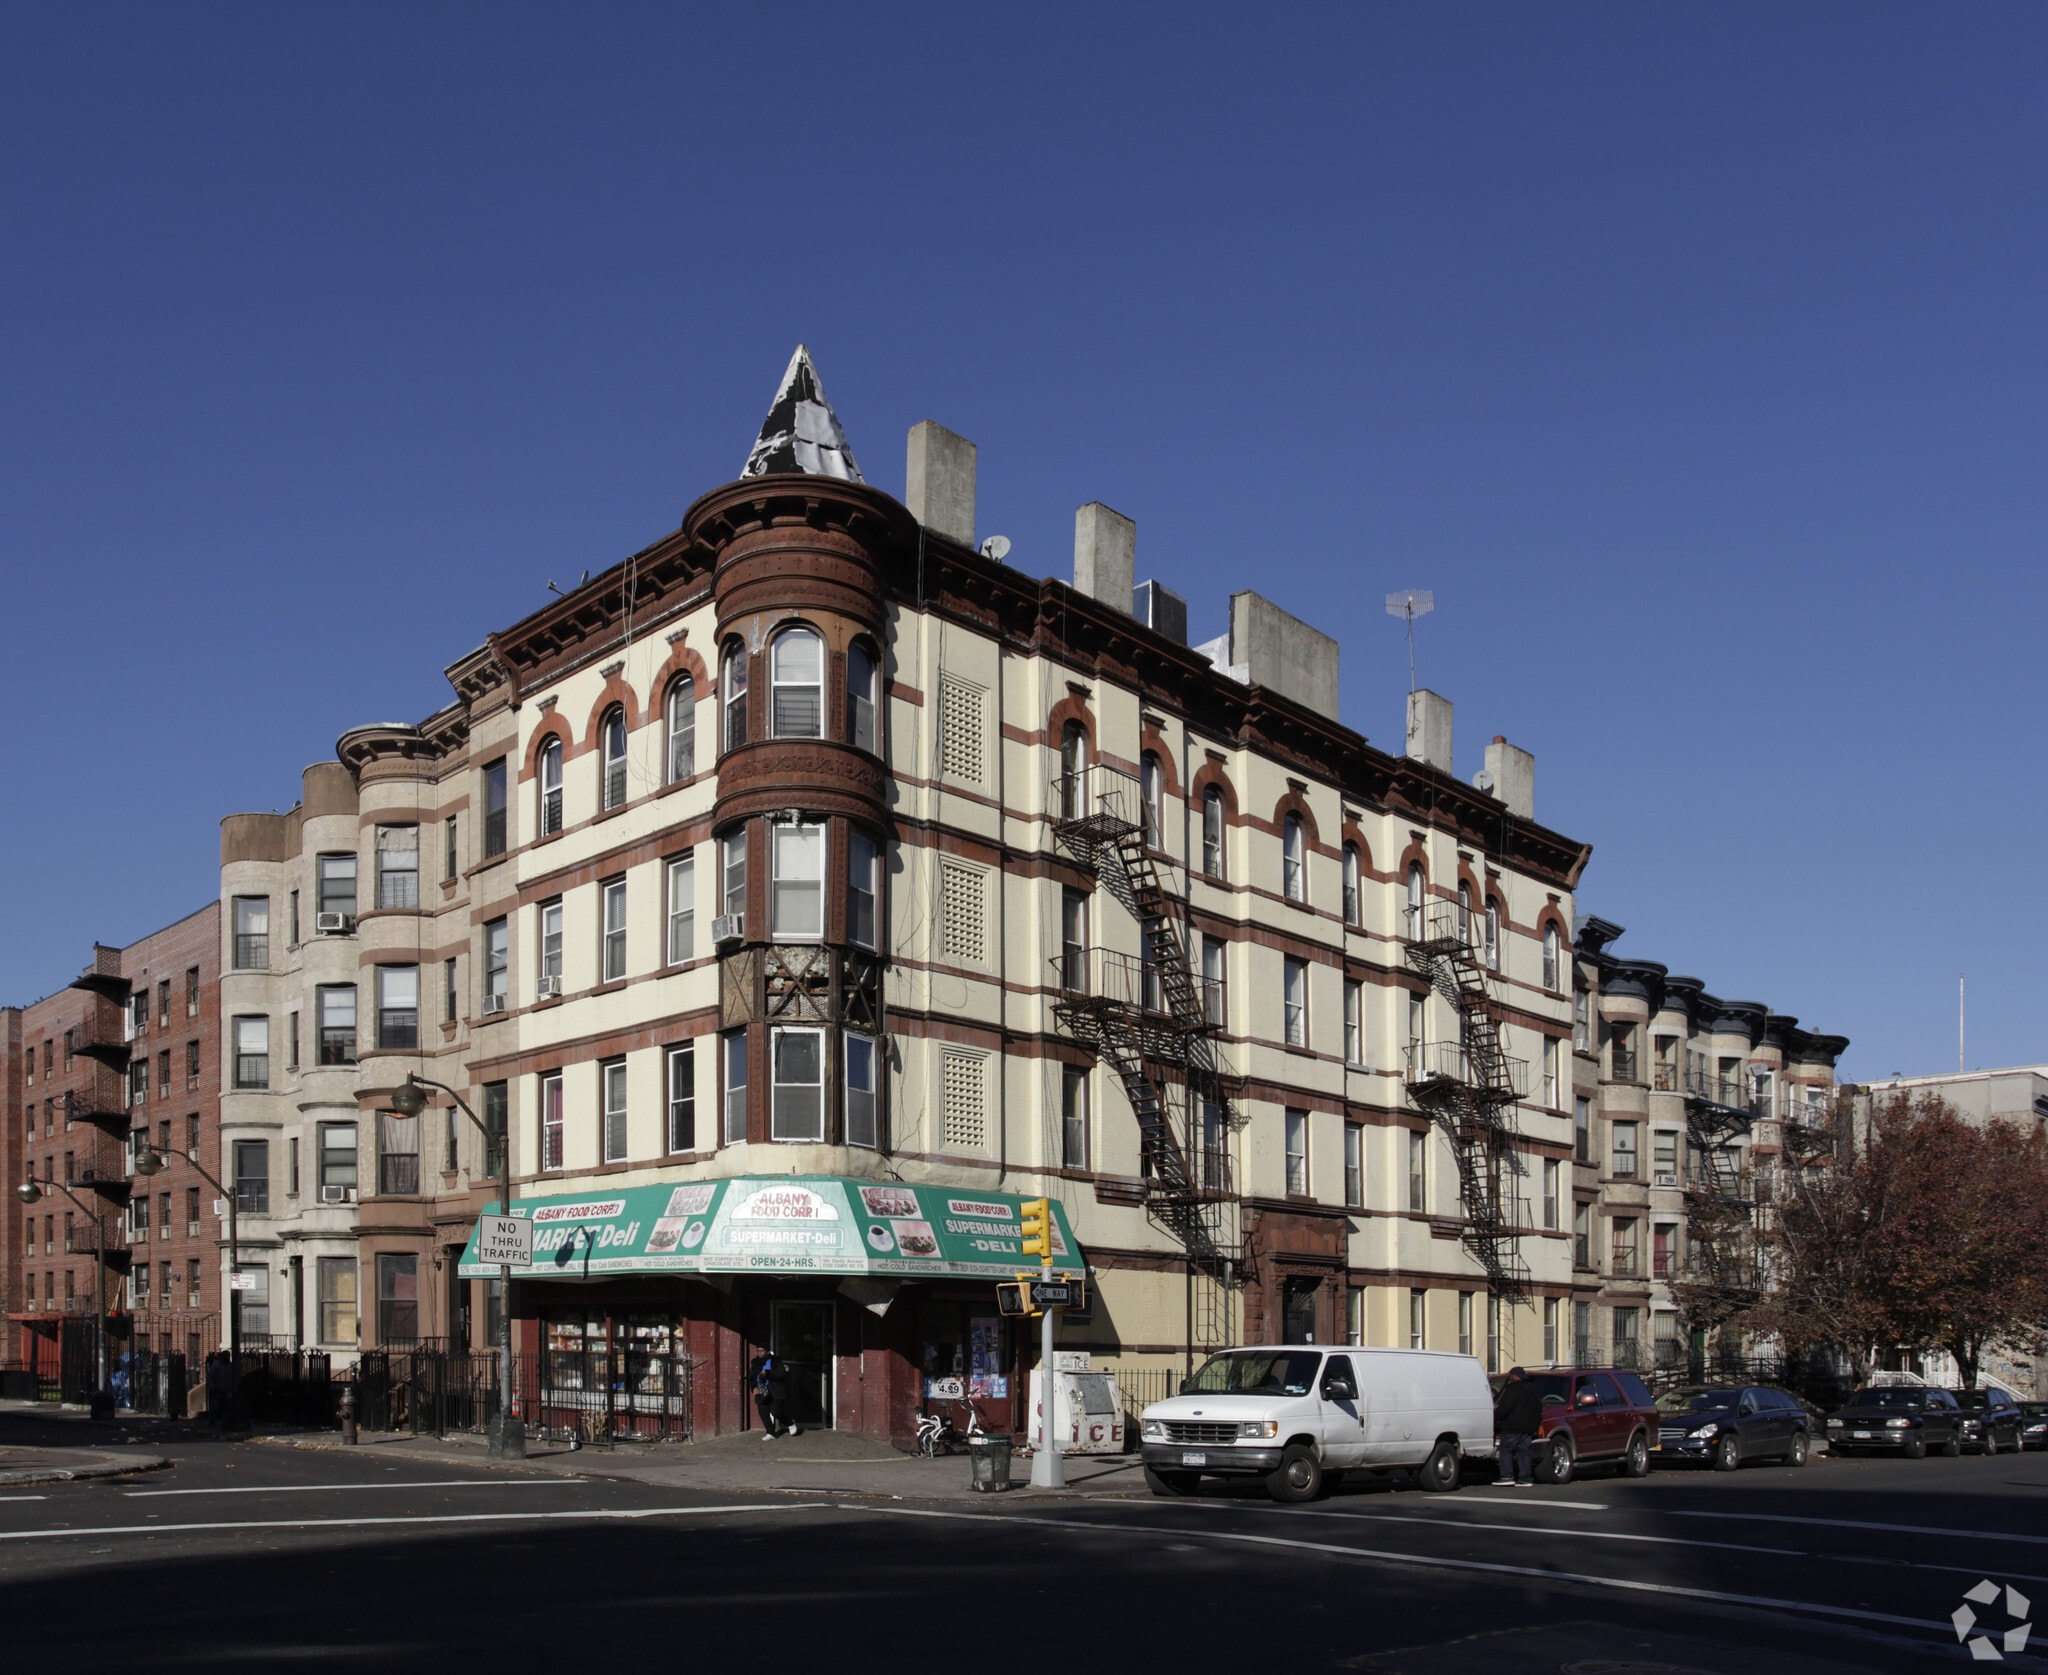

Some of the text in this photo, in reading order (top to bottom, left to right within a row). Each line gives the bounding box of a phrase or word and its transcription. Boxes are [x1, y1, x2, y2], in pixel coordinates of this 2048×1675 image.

[760, 1193, 809, 1205] ALBANY
[535, 1209, 565, 1220] ALBANY
[567, 1206, 589, 1217] FOOD
[751, 1206, 780, 1217] FOOD
[497, 1222, 516, 1234] NO
[946, 1219, 1022, 1238] SUPERMARKE
[491, 1236, 522, 1248] THRU
[483, 1248, 529, 1261] TRAFFIC
[1036, 1289, 1065, 1298] ONE WAY
[1074, 1360, 1088, 1369] ICE
[1072, 1423, 1123, 1443] ICE
